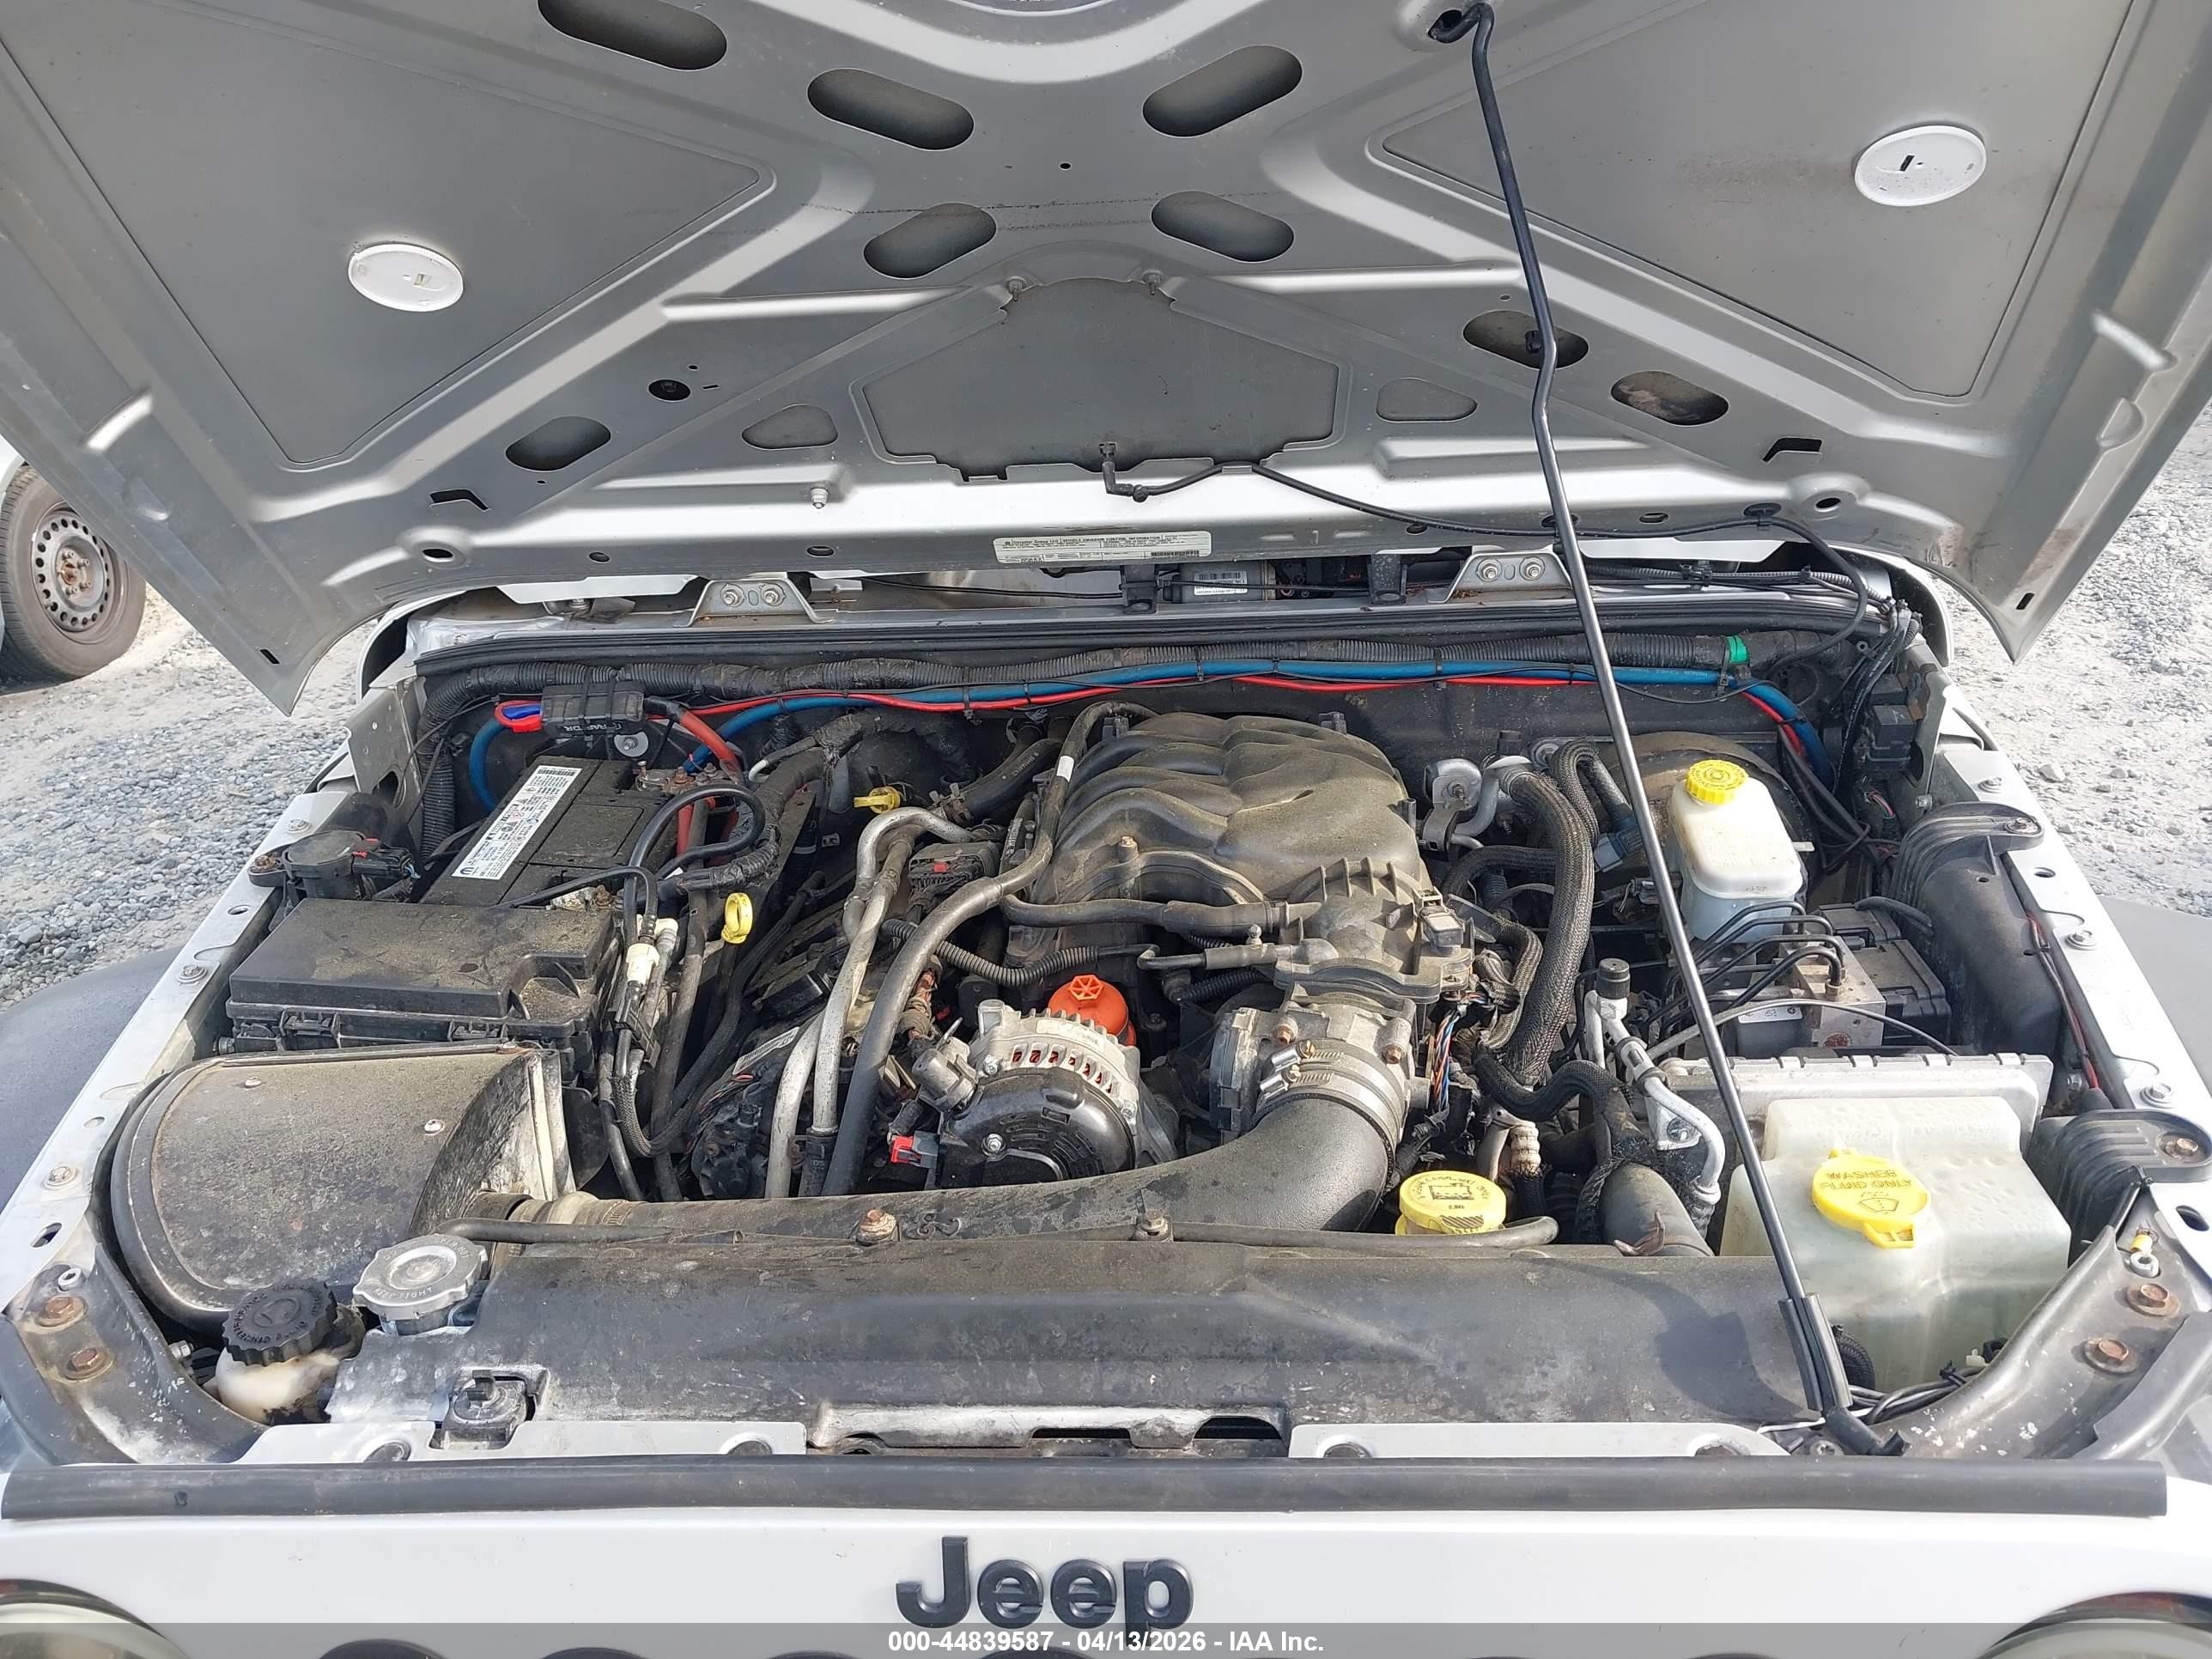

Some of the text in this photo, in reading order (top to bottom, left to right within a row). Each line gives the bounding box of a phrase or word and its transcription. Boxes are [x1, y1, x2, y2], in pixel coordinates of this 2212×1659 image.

[1826, 1170, 1898, 1180] WASHER
[1820, 1179, 1912, 1190] FLUID ONLY
[896, 1536, 1194, 1647] Jeep
